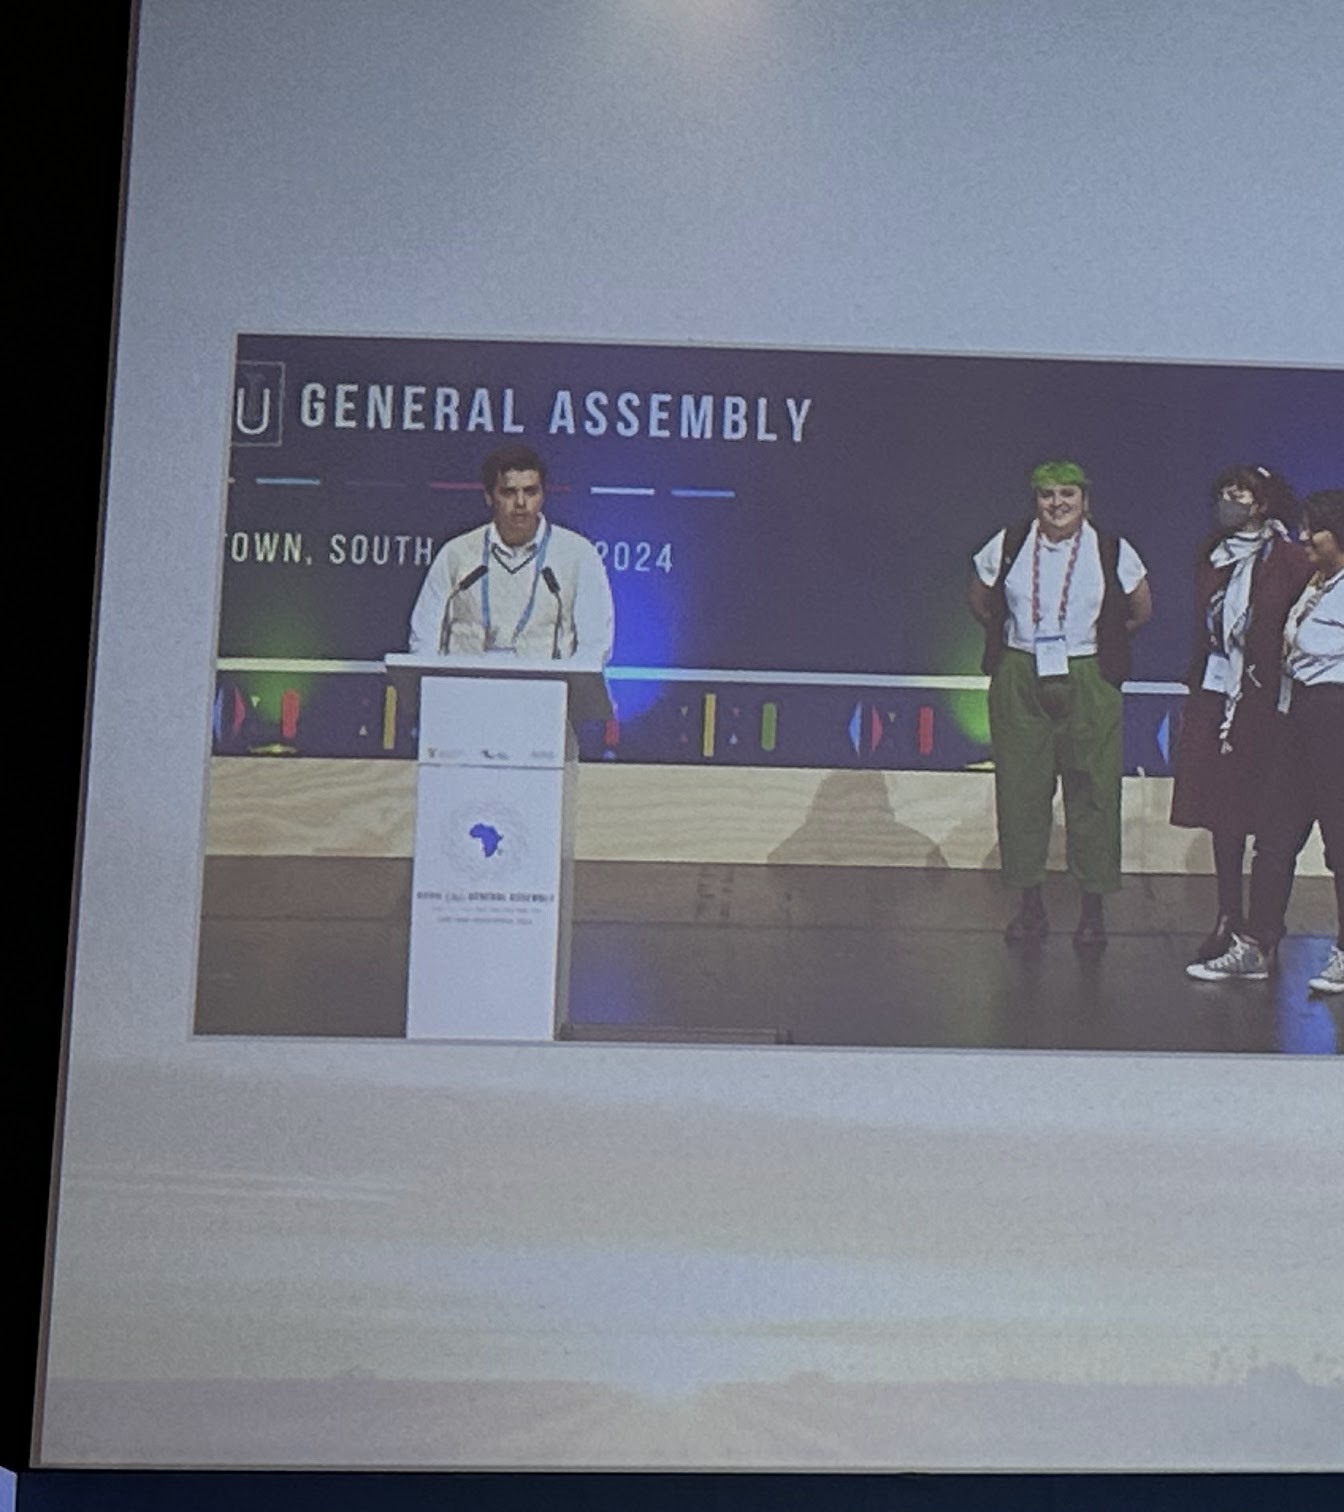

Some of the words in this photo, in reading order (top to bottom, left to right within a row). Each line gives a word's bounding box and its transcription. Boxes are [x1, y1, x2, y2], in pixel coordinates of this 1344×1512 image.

[301, 382, 525, 433] GENERAL
[549, 390, 812, 442] ASSEMBLY
[224, 532, 313, 565] OWN,
[329, 534, 434, 566] SOUTH
